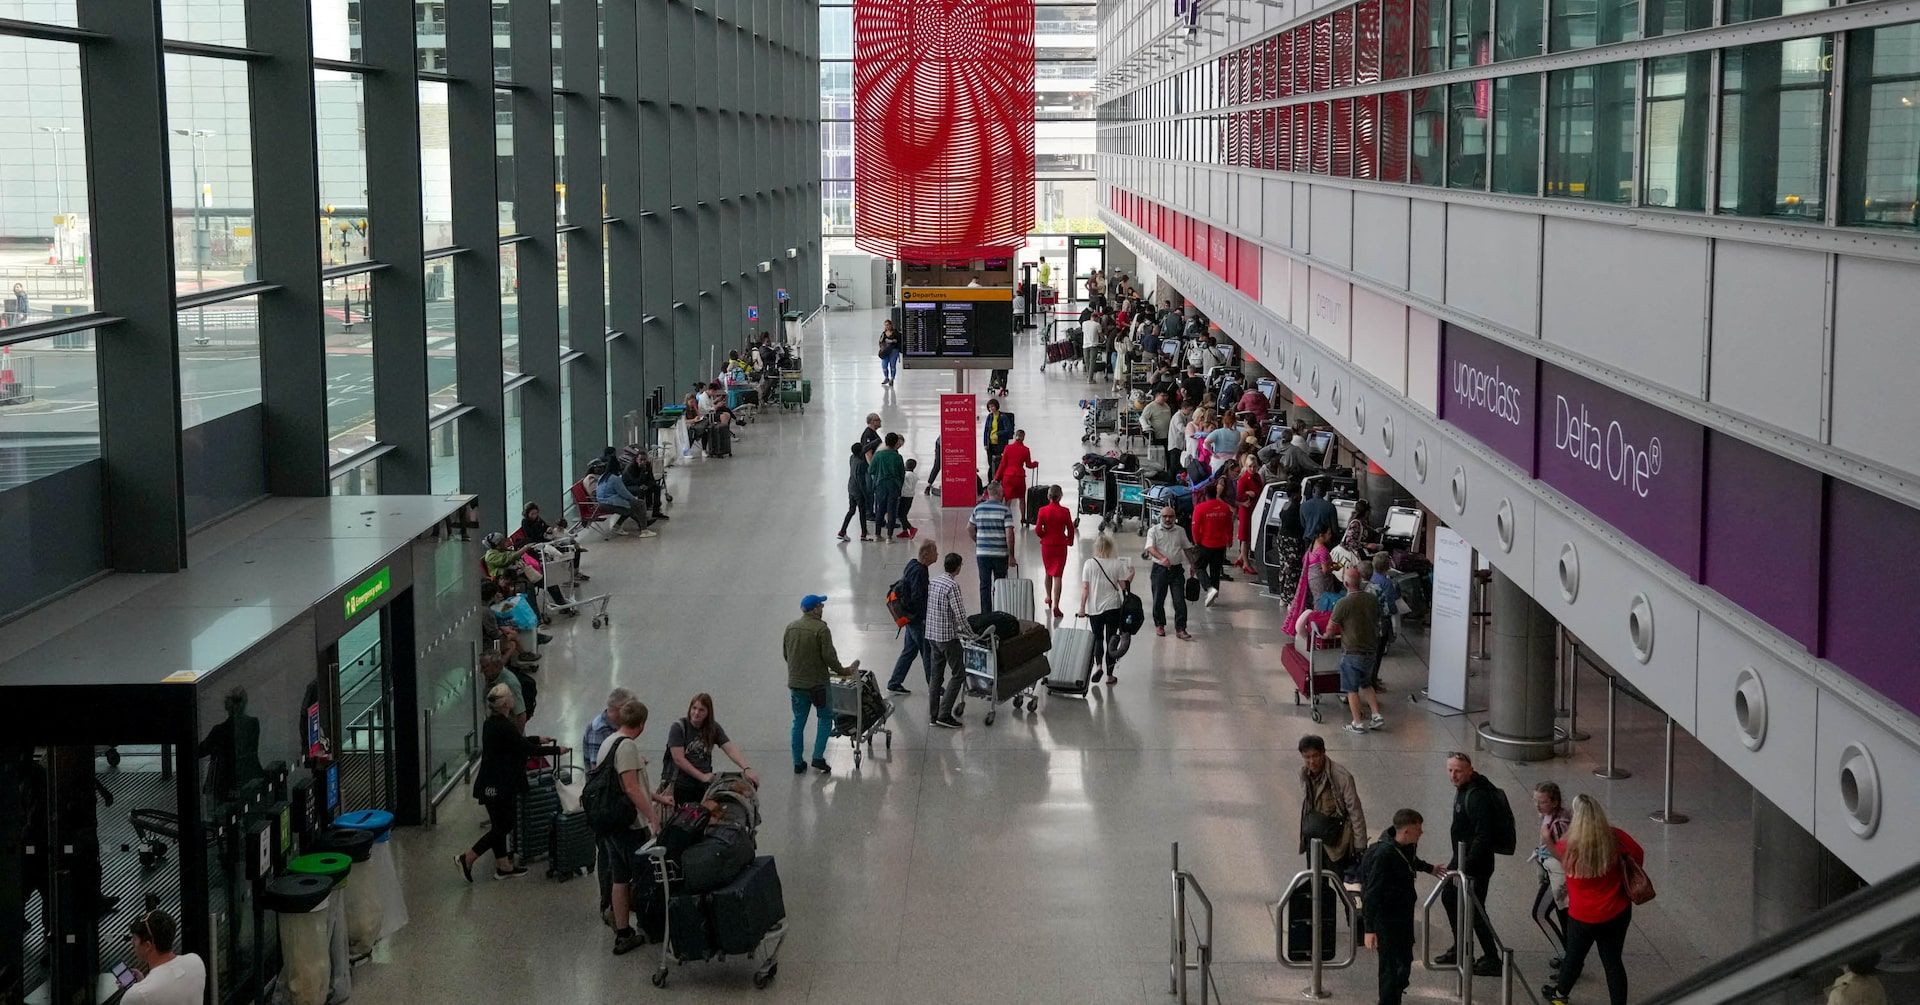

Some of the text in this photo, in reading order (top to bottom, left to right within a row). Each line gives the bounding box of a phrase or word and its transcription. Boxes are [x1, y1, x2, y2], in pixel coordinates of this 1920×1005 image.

[1453, 360, 1521, 426] upperclass
[1555, 394, 1601, 471] Delta
[356, 581, 383, 606] Emergency exit
